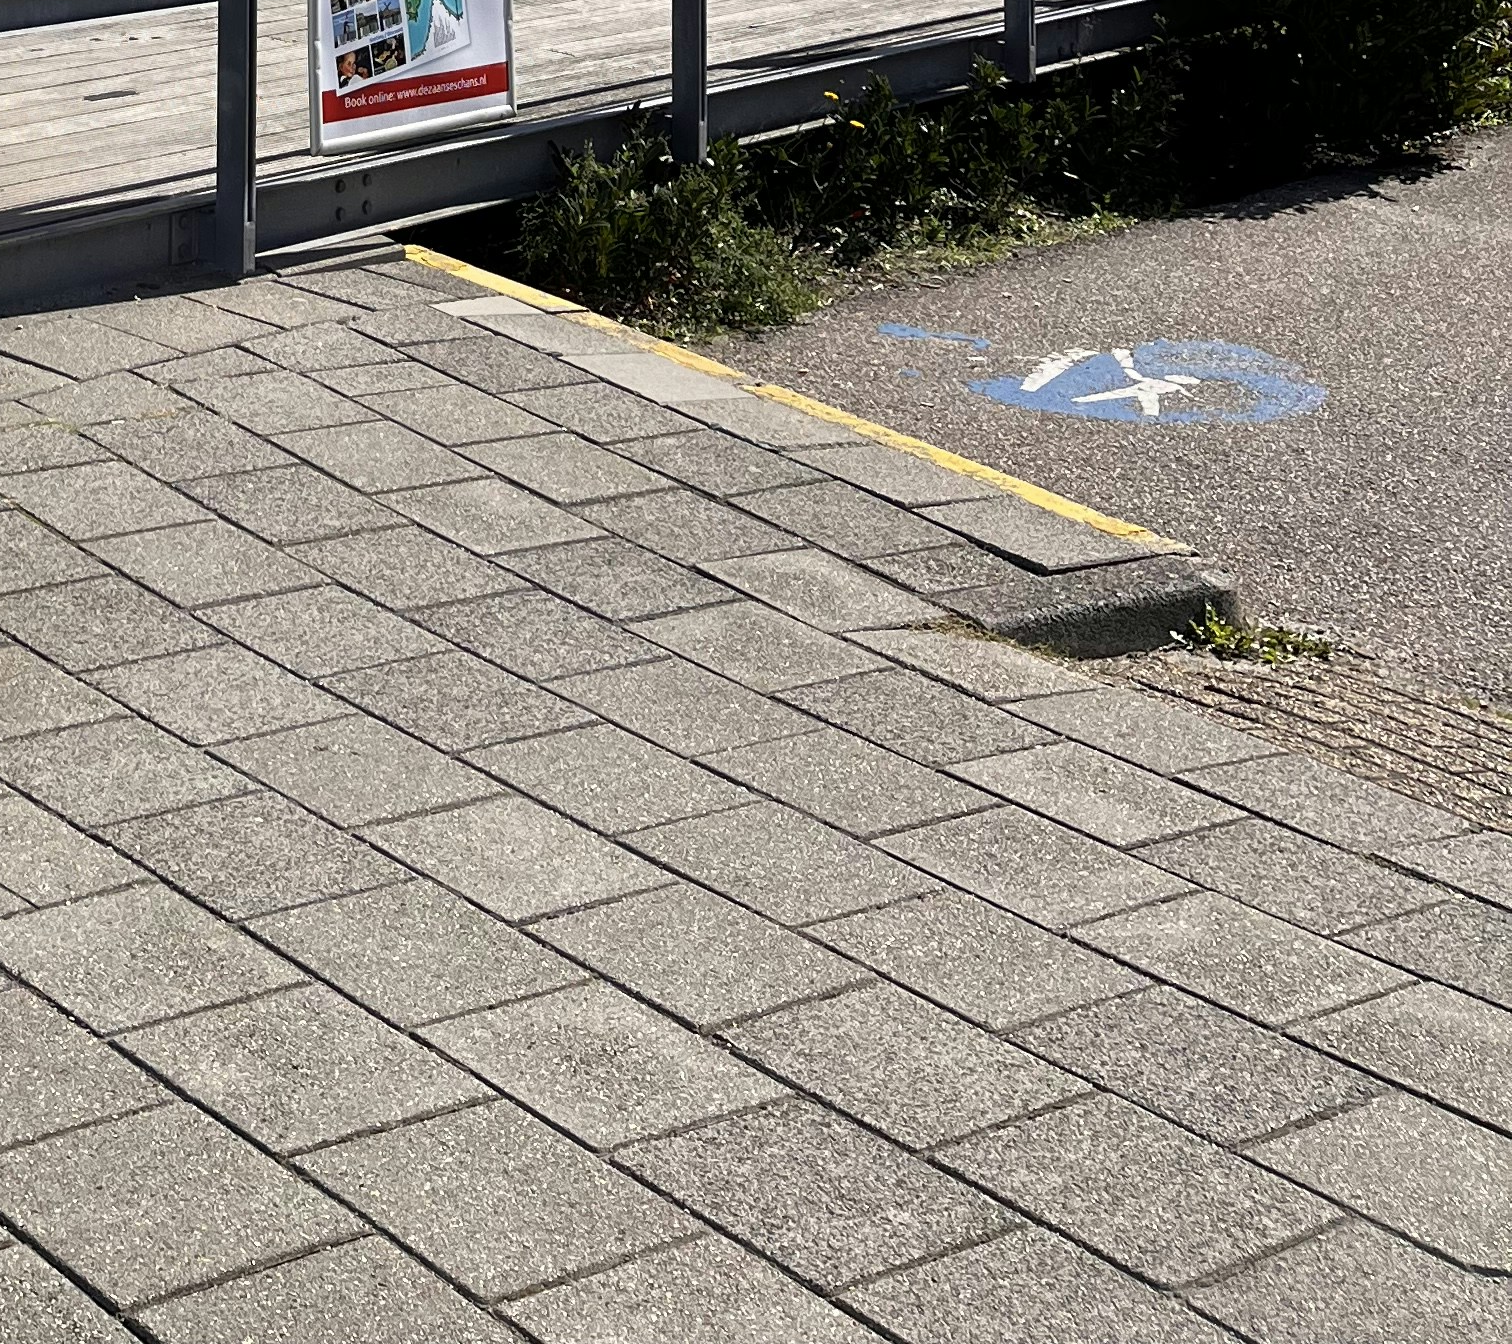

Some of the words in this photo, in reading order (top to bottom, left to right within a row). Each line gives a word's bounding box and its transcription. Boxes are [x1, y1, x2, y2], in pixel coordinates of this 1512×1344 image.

[344, 94, 367, 109] Book
[368, 91, 396, 104] online:
[396, 74, 487, 100] www.dezaanseschans.nl
